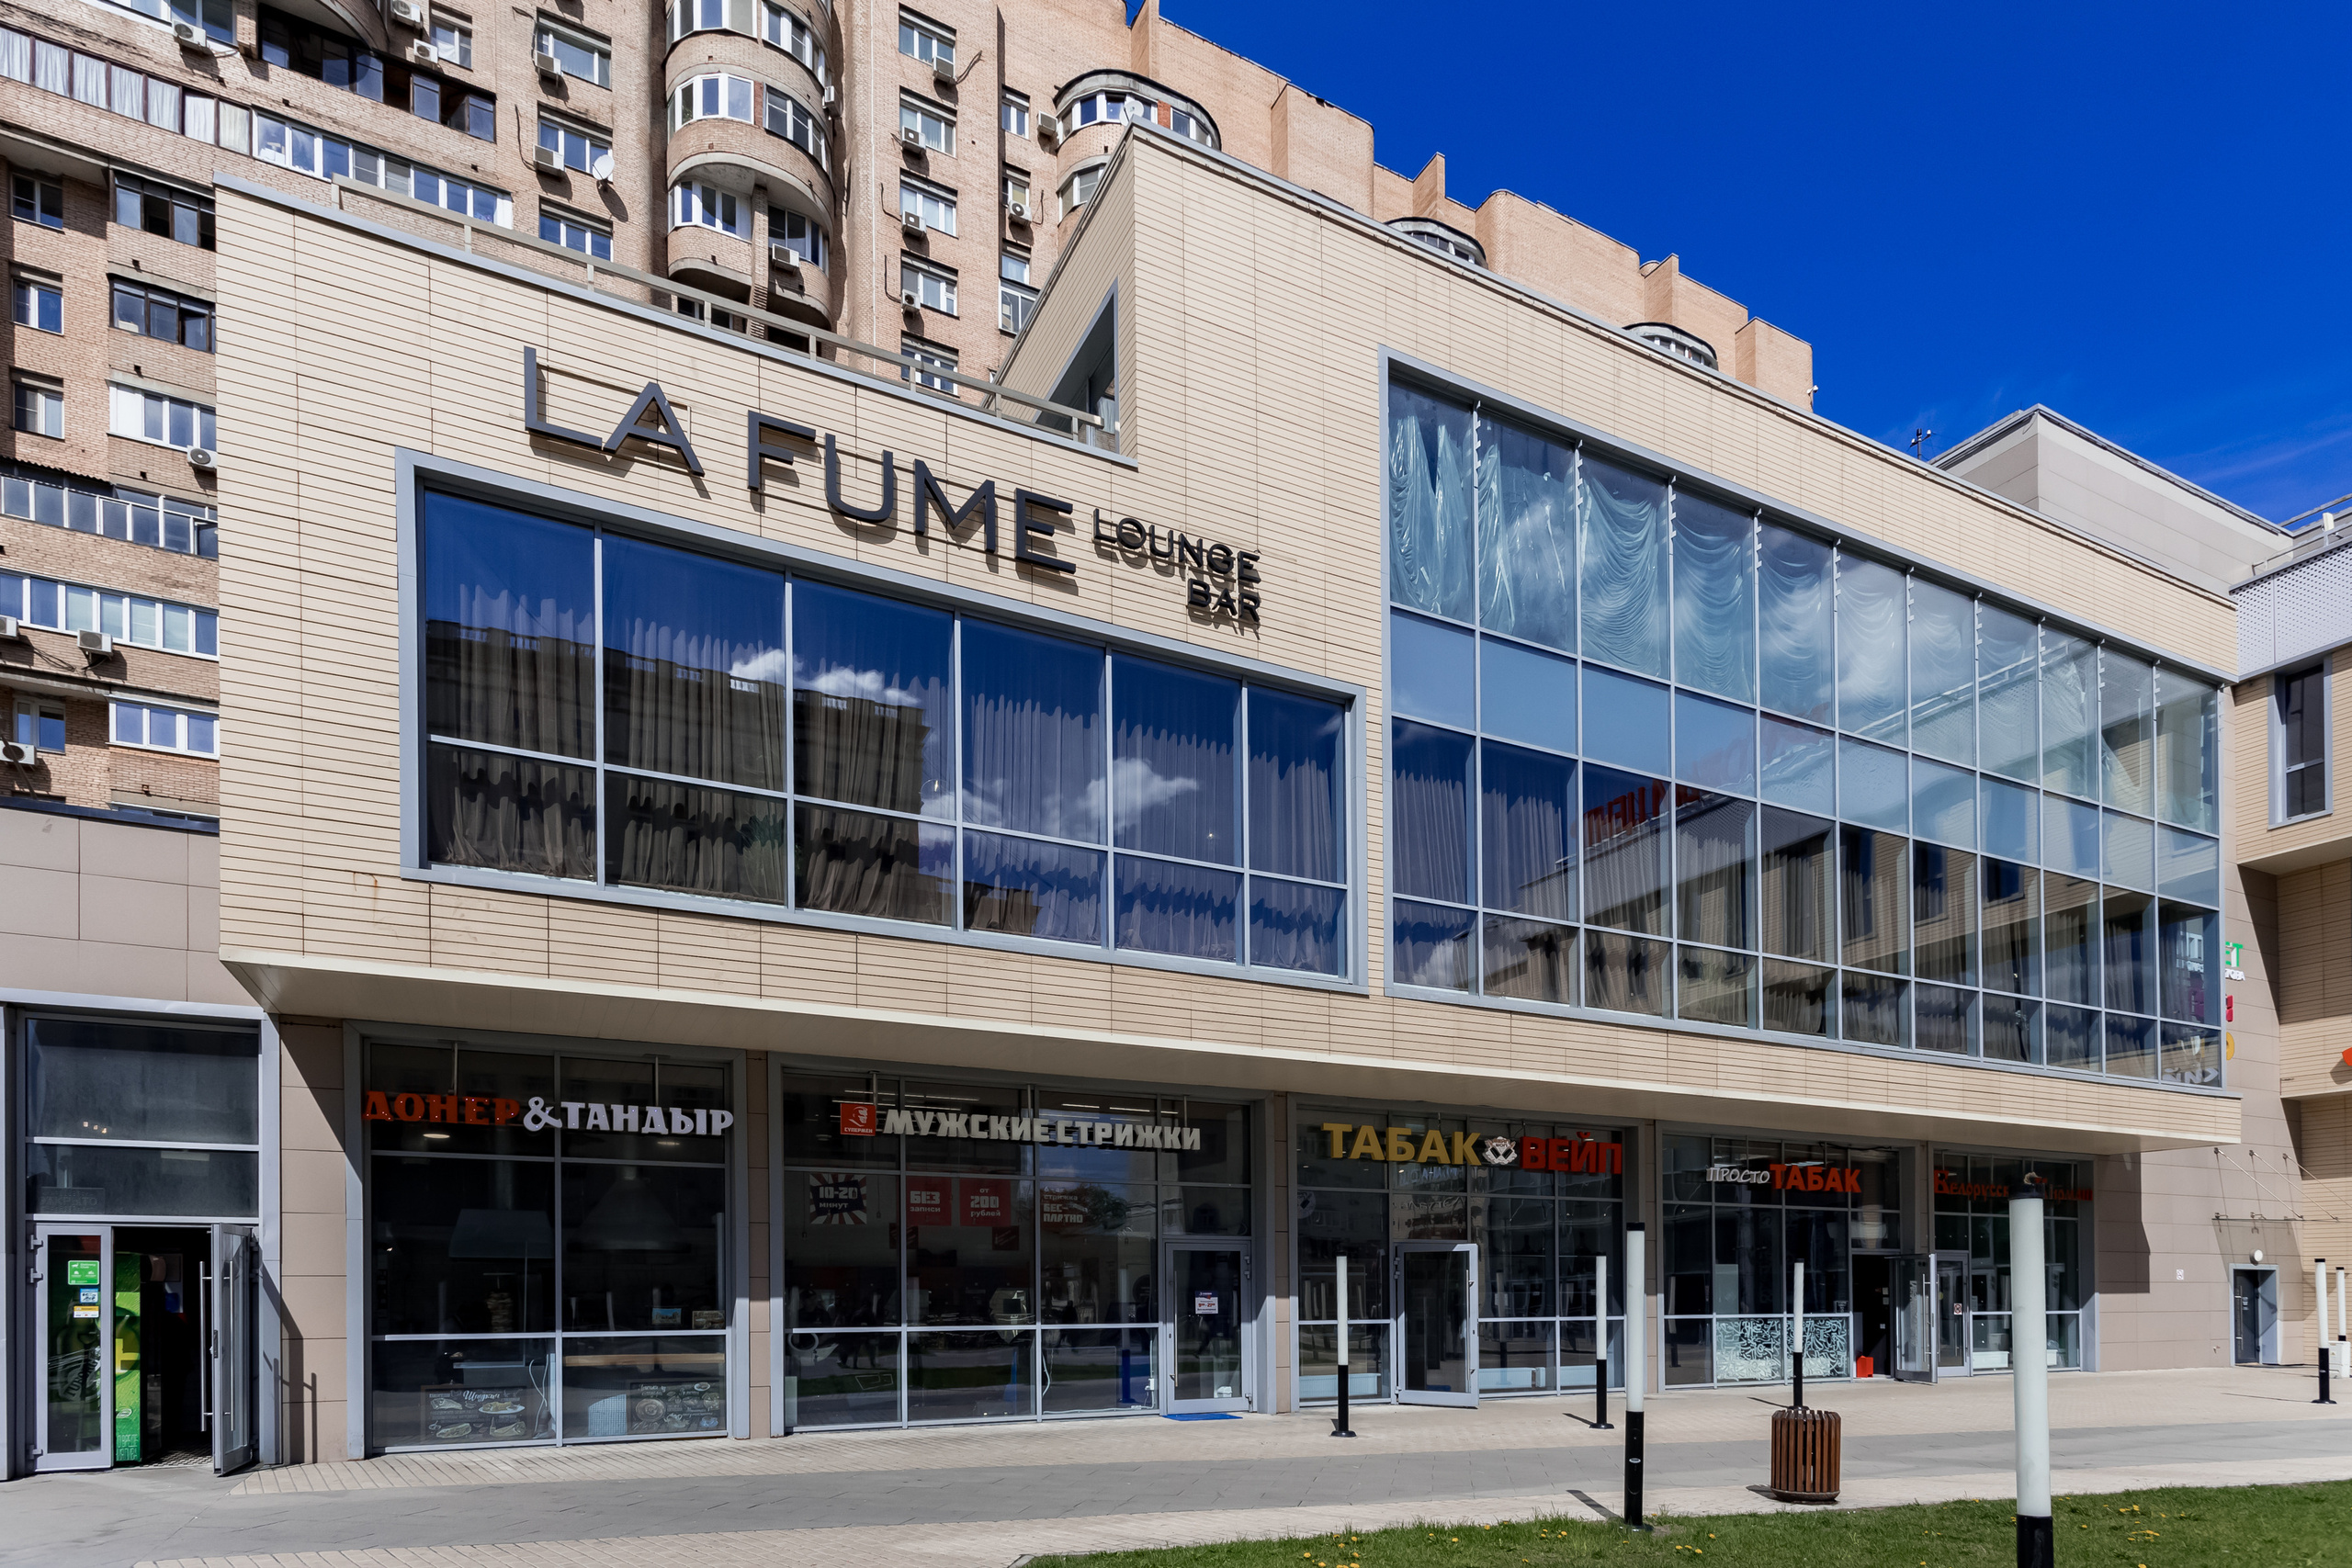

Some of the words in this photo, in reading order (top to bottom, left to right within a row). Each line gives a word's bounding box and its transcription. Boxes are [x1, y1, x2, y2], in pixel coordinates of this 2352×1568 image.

[524, 345, 705, 477] LA
[747, 410, 1077, 575] FUME
[1092, 508, 1261, 584] LOUNGE
[1187, 578, 1261, 623] BAR
[362, 1090, 521, 1126] ДОНЕР
[560, 1101, 734, 1136] ТАНДЫР
[883, 1109, 1050, 1143] МУЖСКИЕ
[1054, 1119, 1201, 1151] СТРИЖКИ
[1321, 1122, 1482, 1167] ТАБАК
[1520, 1131, 1623, 1175] ВЕЙП
[819, 1186, 859, 1200] 10-20
[1706, 1167, 1770, 1184] ПРОСТО
[1770, 1164, 1863, 1193] ТАБАК
[820, 1201, 849, 1210] минут
[910, 1190, 941, 1204] БЕЗ
[970, 1195, 1000, 1209] 200
[970, 1209, 1001, 1218] рублей
[1043, 1213, 1084, 1224] ПЛАТНО
